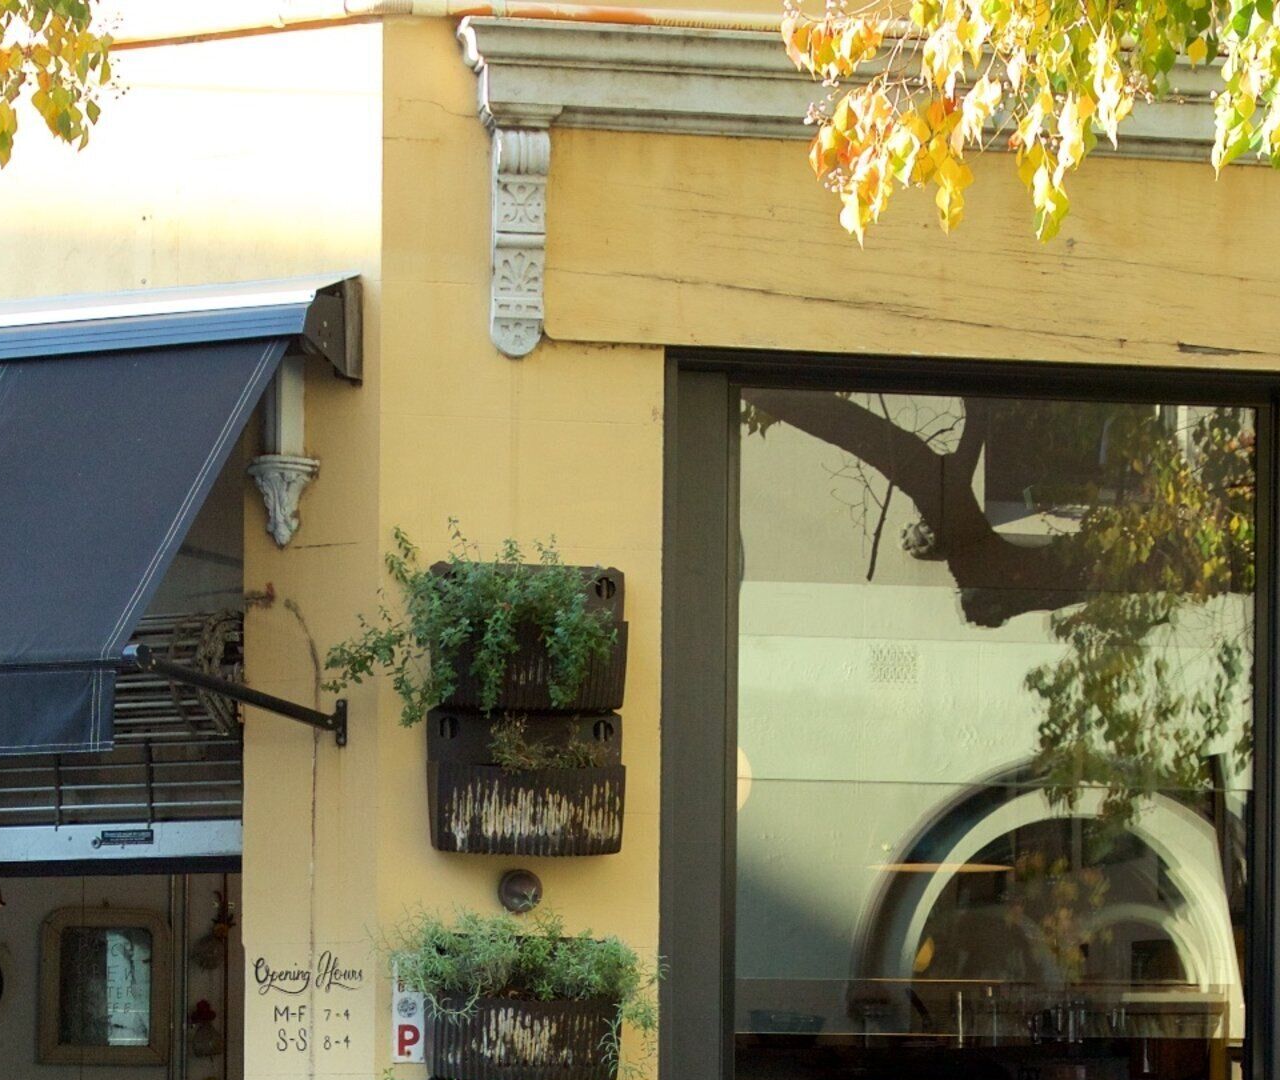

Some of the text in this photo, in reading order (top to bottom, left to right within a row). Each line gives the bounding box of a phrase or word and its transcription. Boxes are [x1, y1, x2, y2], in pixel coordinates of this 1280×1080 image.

[251, 956, 312, 996] Opening
[315, 950, 364, 993] Hours
[273, 1004, 307, 1023] M-F
[275, 1027, 308, 1052] S-S
